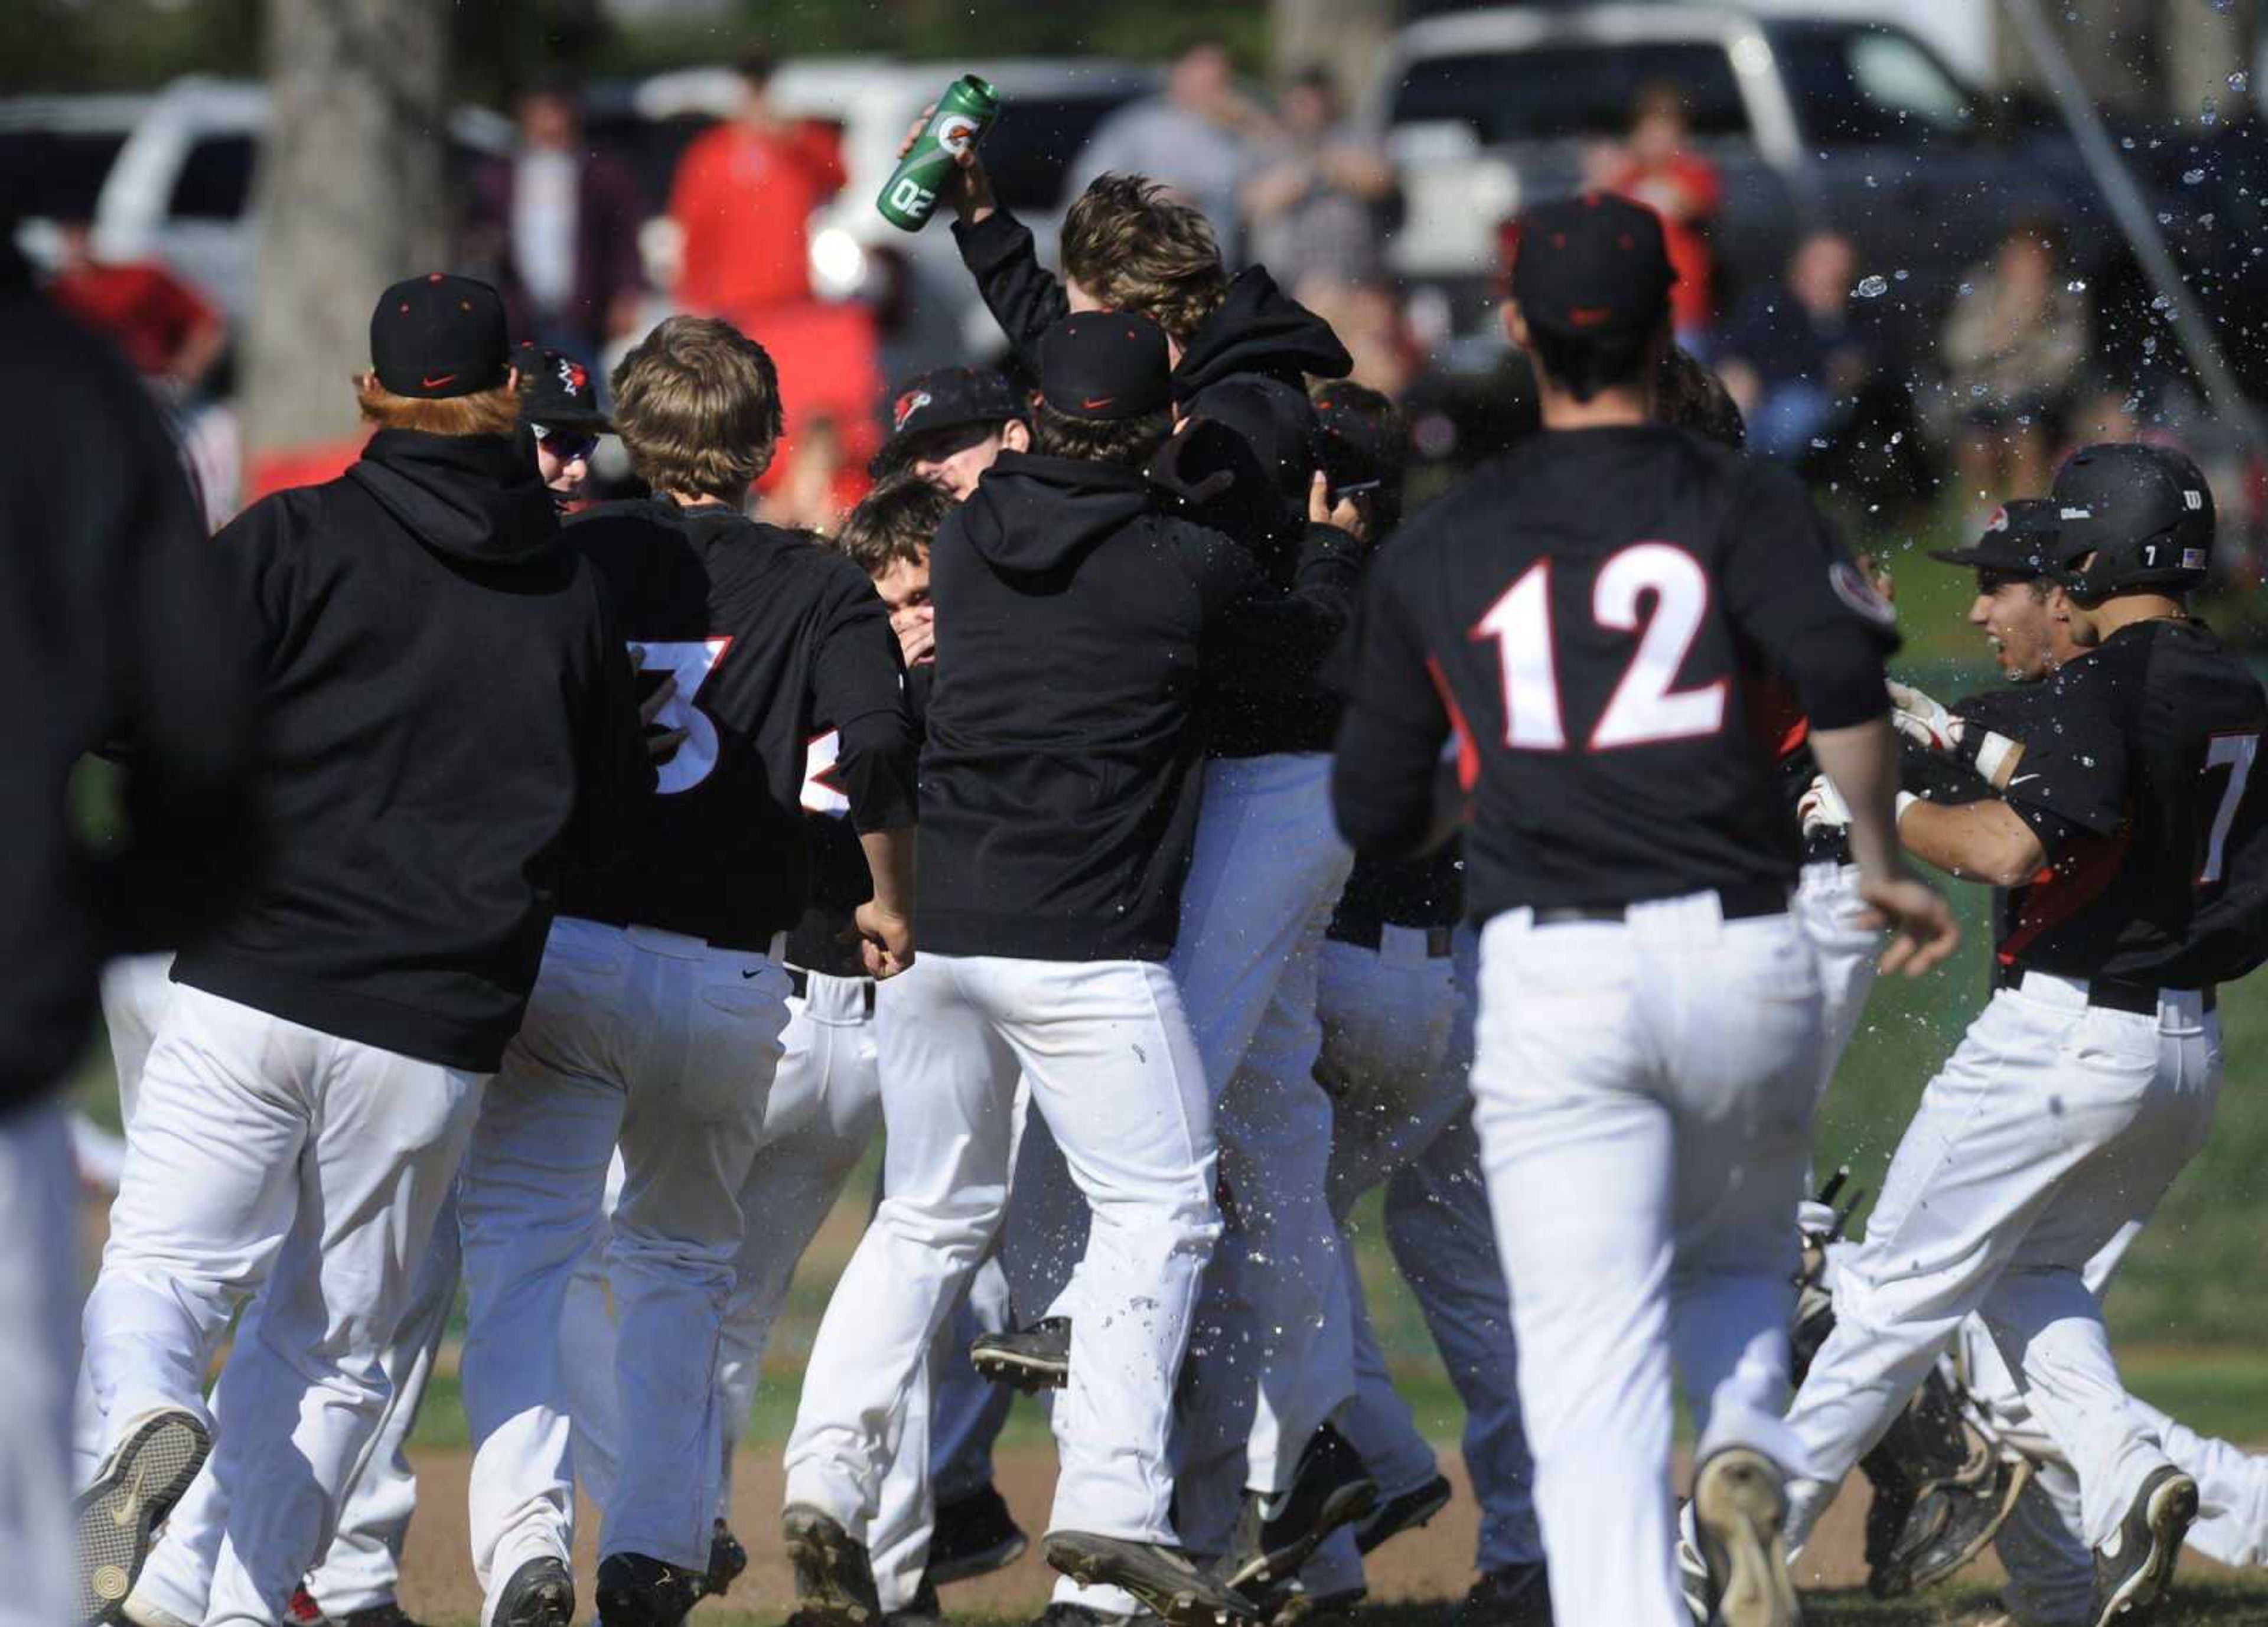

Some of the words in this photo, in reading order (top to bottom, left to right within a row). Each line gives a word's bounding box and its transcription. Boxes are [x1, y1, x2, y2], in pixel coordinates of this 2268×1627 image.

[2145, 544, 2156, 567] 7
[1467, 540, 1731, 752] 12
[2196, 731, 2262, 886] 7
